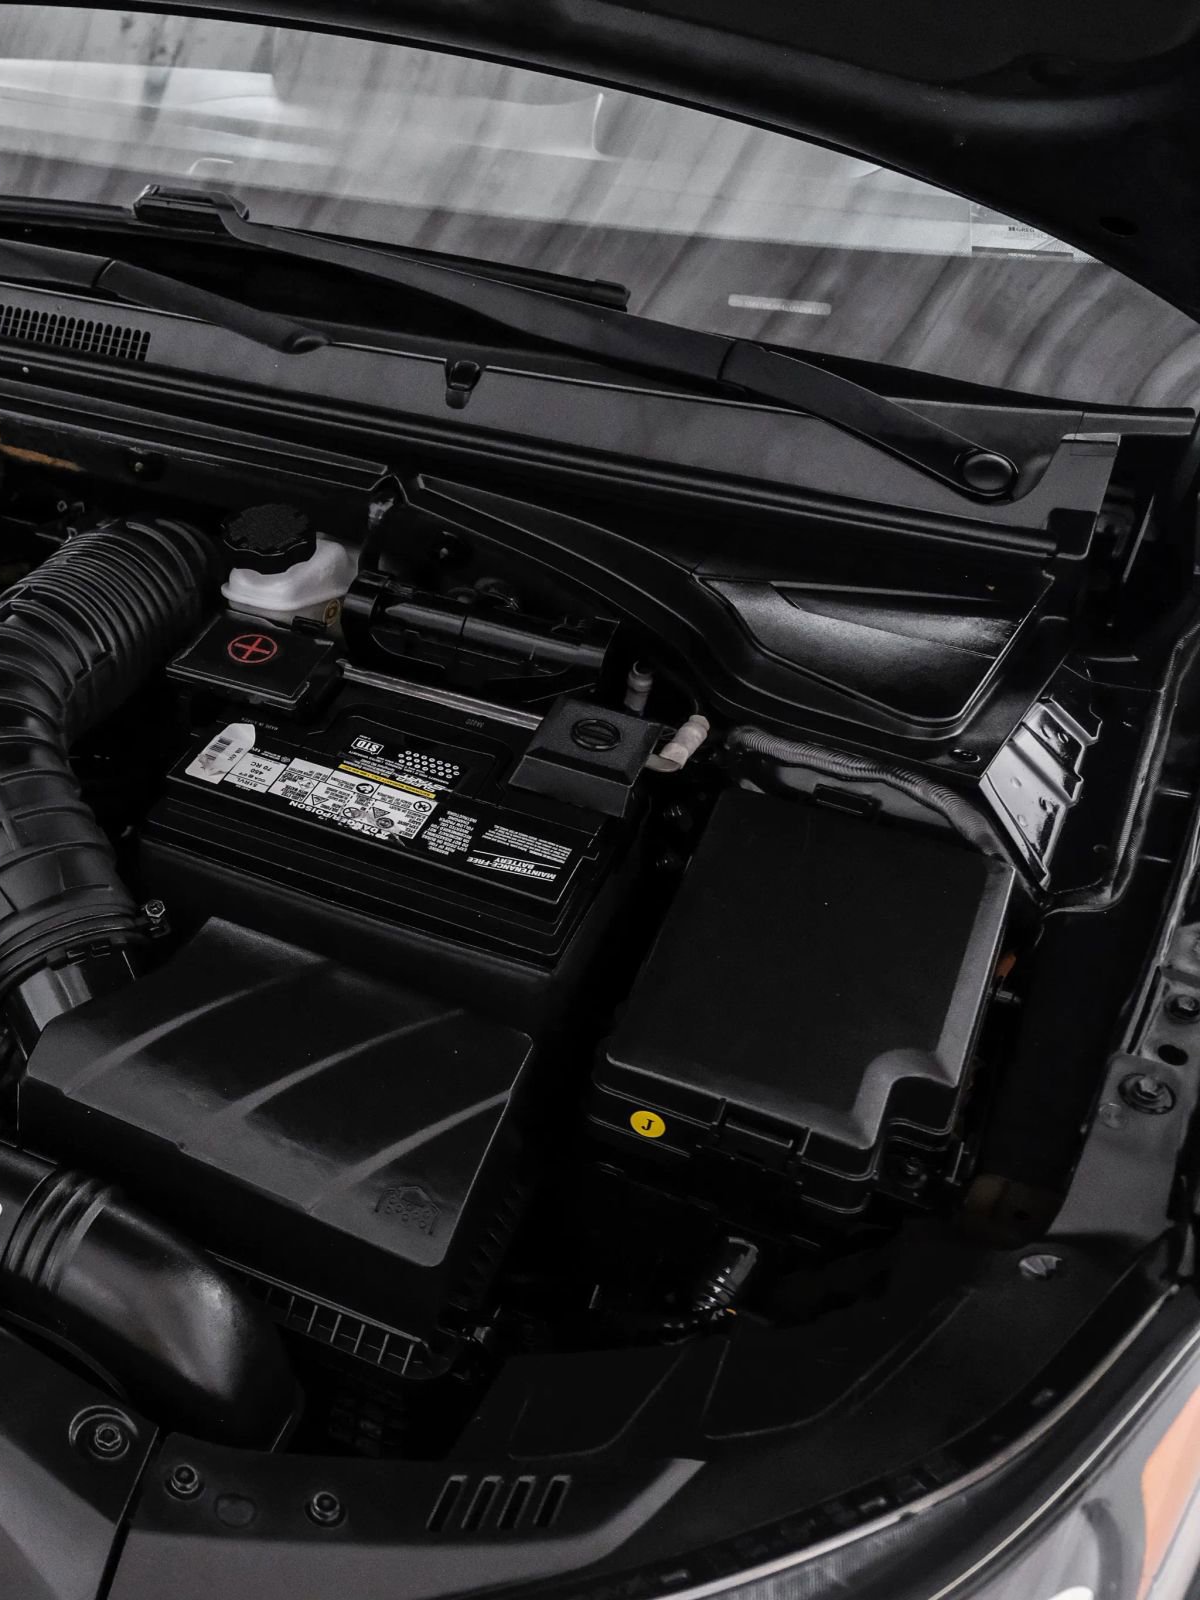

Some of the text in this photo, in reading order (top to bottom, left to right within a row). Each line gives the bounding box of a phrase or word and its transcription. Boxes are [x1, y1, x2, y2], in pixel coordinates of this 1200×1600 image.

[356, 740, 379, 752] STD
[289, 800, 378, 832] DANGER/POISON
[466, 856, 556, 879] MAINTENANCE-FREE
[493, 856, 534, 869] BATTERY
[641, 1119, 655, 1130] J
